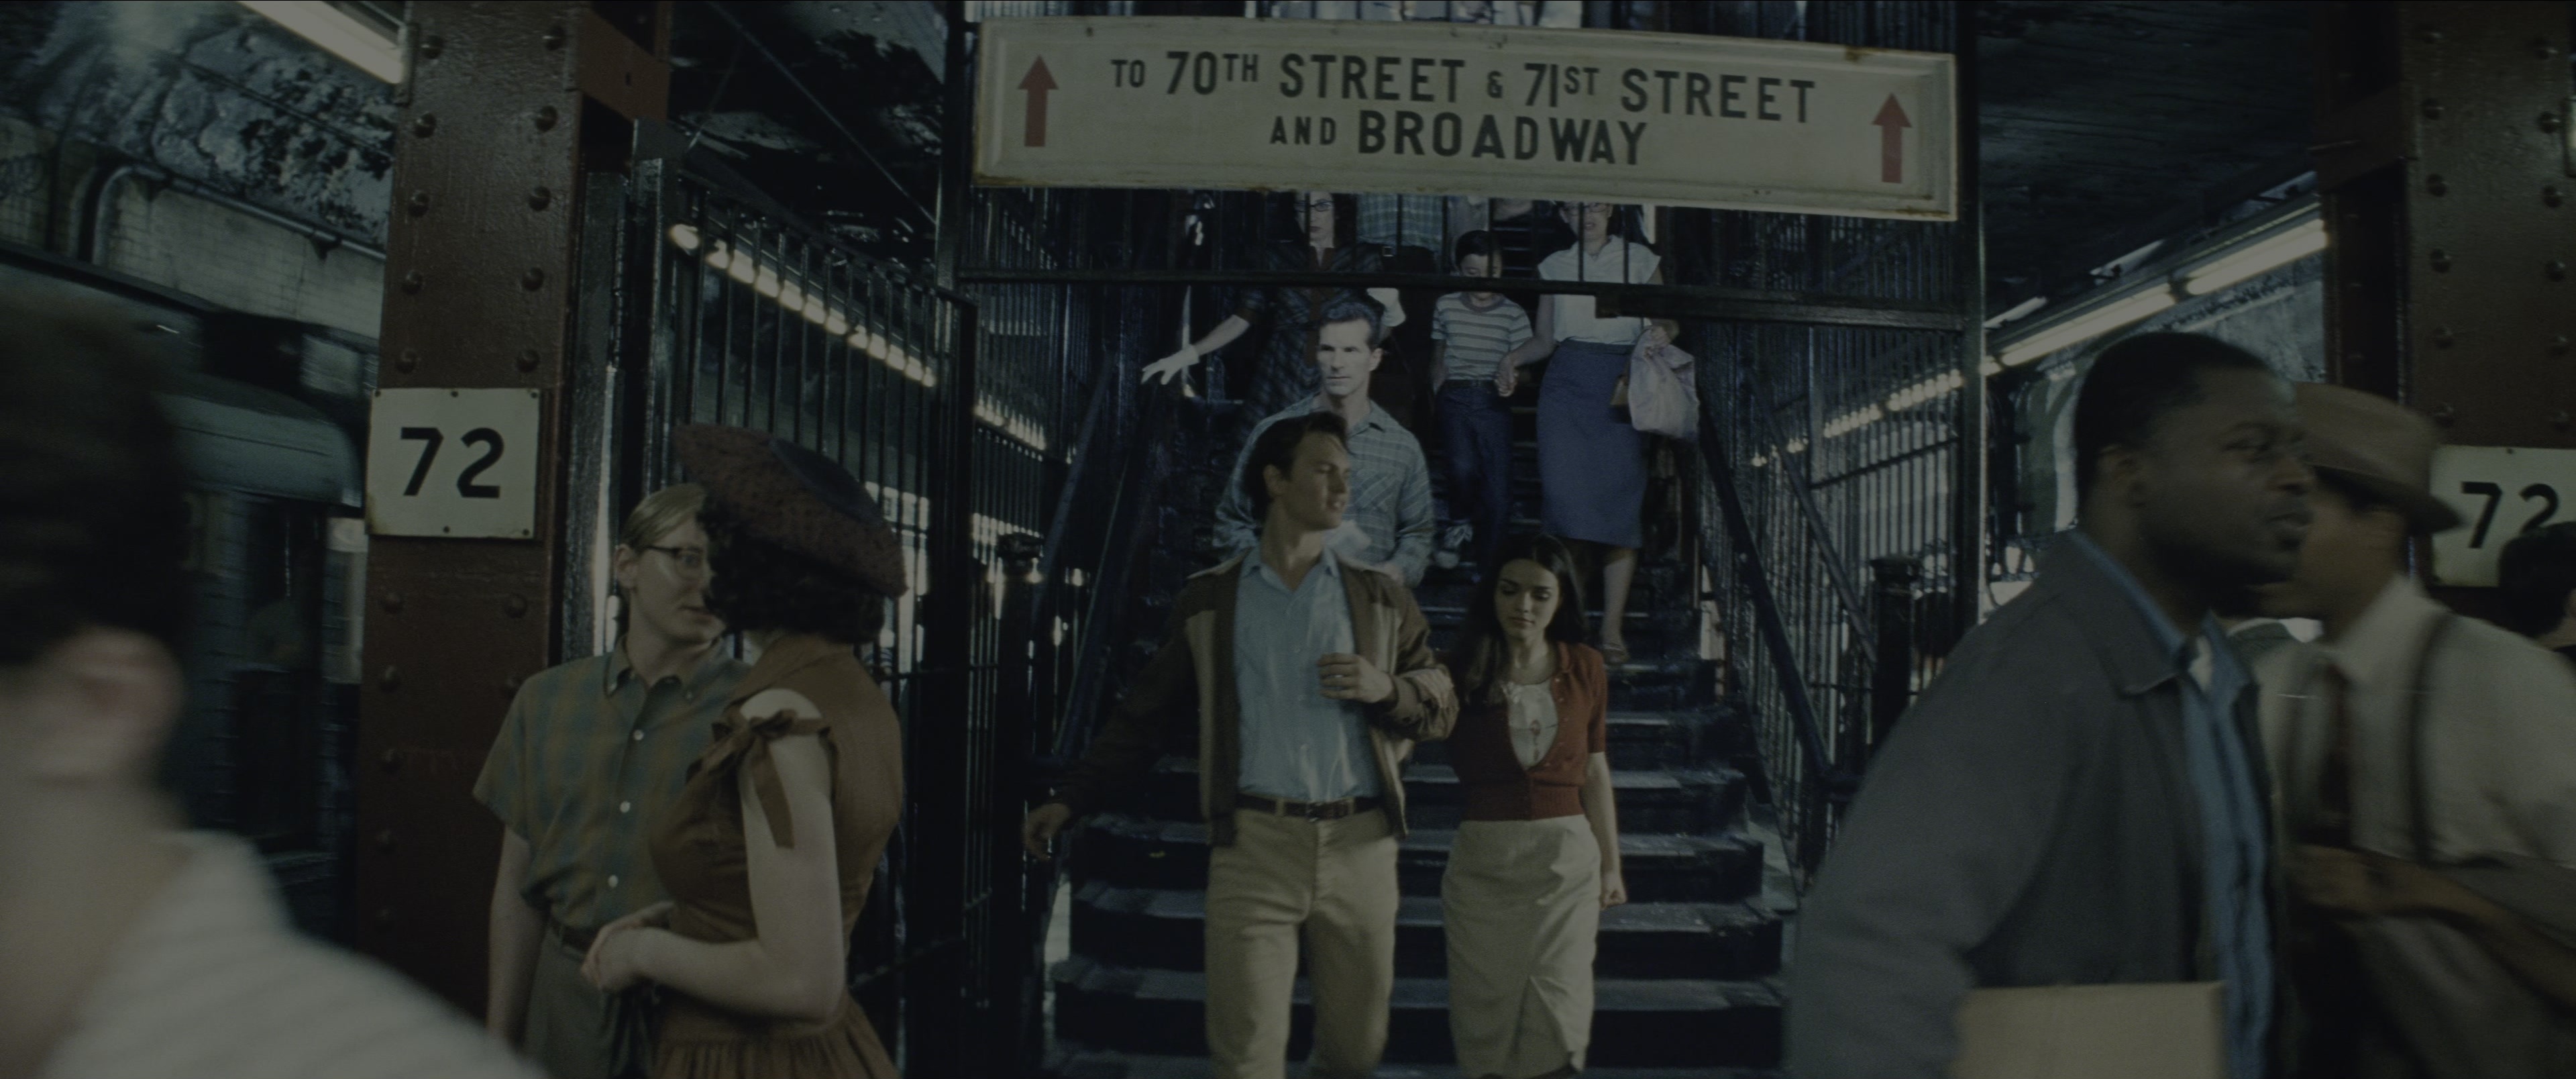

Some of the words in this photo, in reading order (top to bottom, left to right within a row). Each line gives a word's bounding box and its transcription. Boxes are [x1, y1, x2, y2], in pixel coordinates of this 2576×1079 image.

[1111, 59, 1145, 88] TO
[1166, 51, 1259, 95] 70TH
[1279, 53, 1465, 103] STREET
[1486, 70, 1503, 99] &
[1524, 63, 1599, 107] 71ST
[1621, 68, 1815, 123] STREET
[1270, 115, 1336, 146] AND
[1358, 109, 1647, 165] BROADWAY
[400, 427, 504, 499] 72
[2461, 481, 2559, 549] 72
